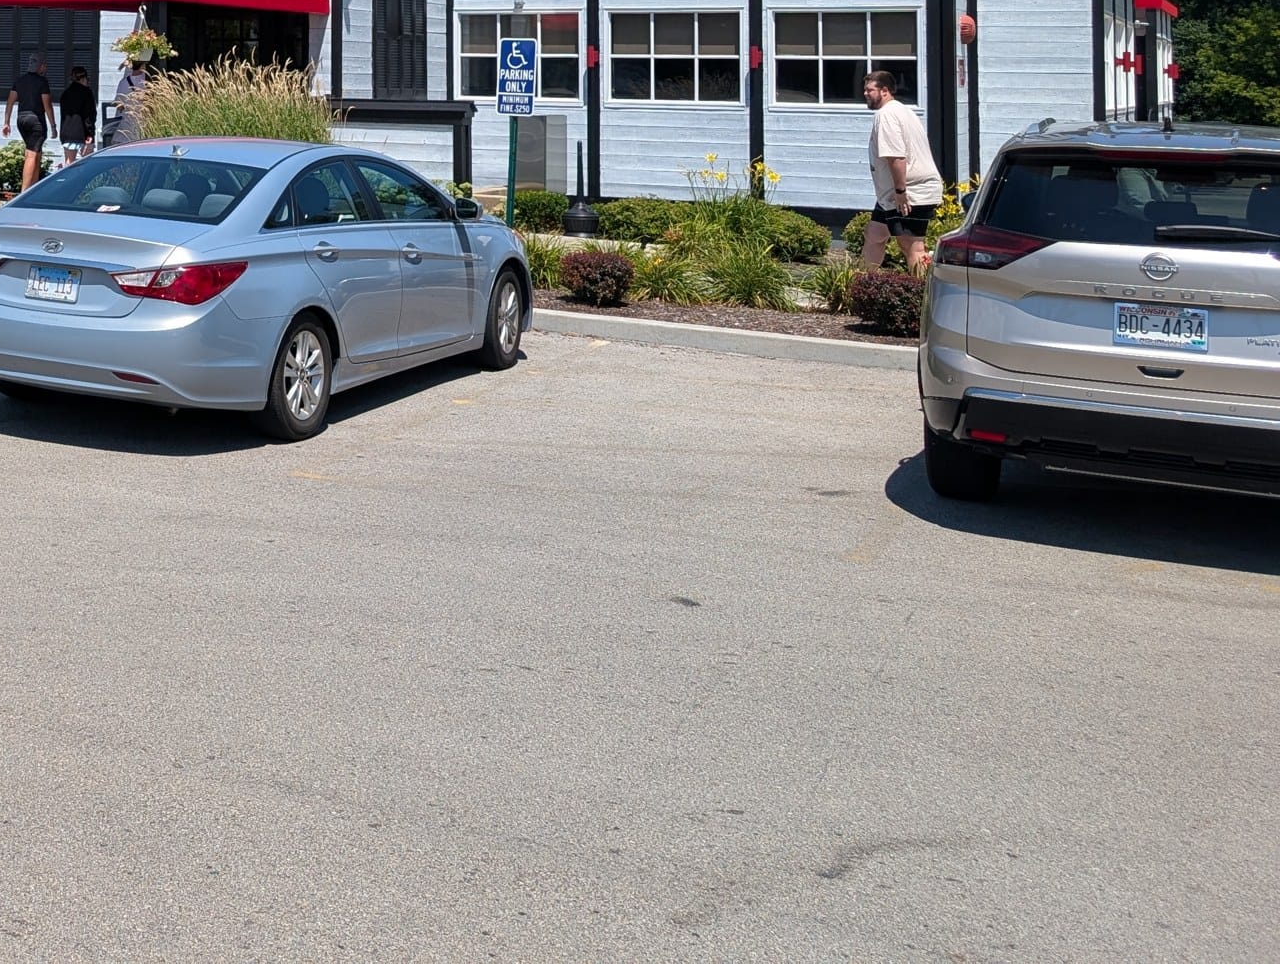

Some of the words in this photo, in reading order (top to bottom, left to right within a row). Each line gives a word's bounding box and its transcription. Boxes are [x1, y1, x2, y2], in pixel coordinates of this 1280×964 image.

[500, 69, 534, 81] PARKING
[505, 81, 527, 93] ONLY
[502, 96, 529, 104] MINIMUM
[500, 104, 514, 113] FINE
[1140, 264, 1177, 273] NISSAN
[31, 275, 50, 292] LEC
[1094, 285, 1223, 301] ROGUE
[1118, 314, 1204, 340] BDC-4434
